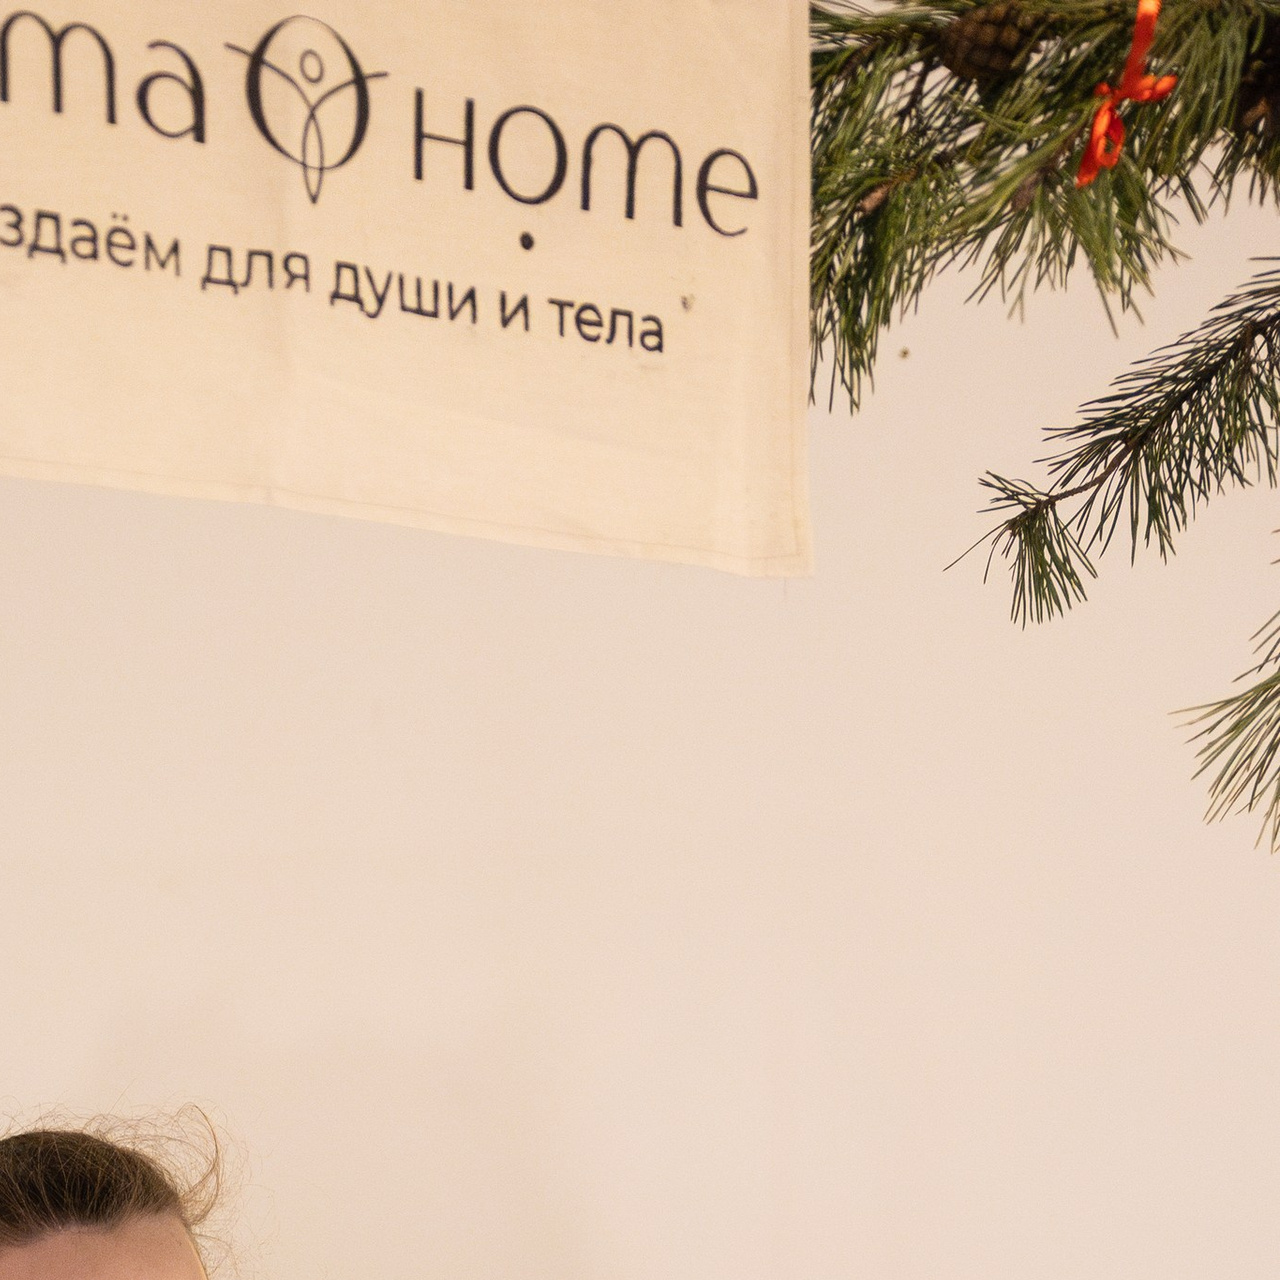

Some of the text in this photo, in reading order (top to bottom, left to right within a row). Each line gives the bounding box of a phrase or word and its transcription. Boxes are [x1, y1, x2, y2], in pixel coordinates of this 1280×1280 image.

[201, 242, 312, 296] для
[330, 260, 477, 319] души
[499, 289, 530, 332] и
[548, 297, 664, 354] тела
